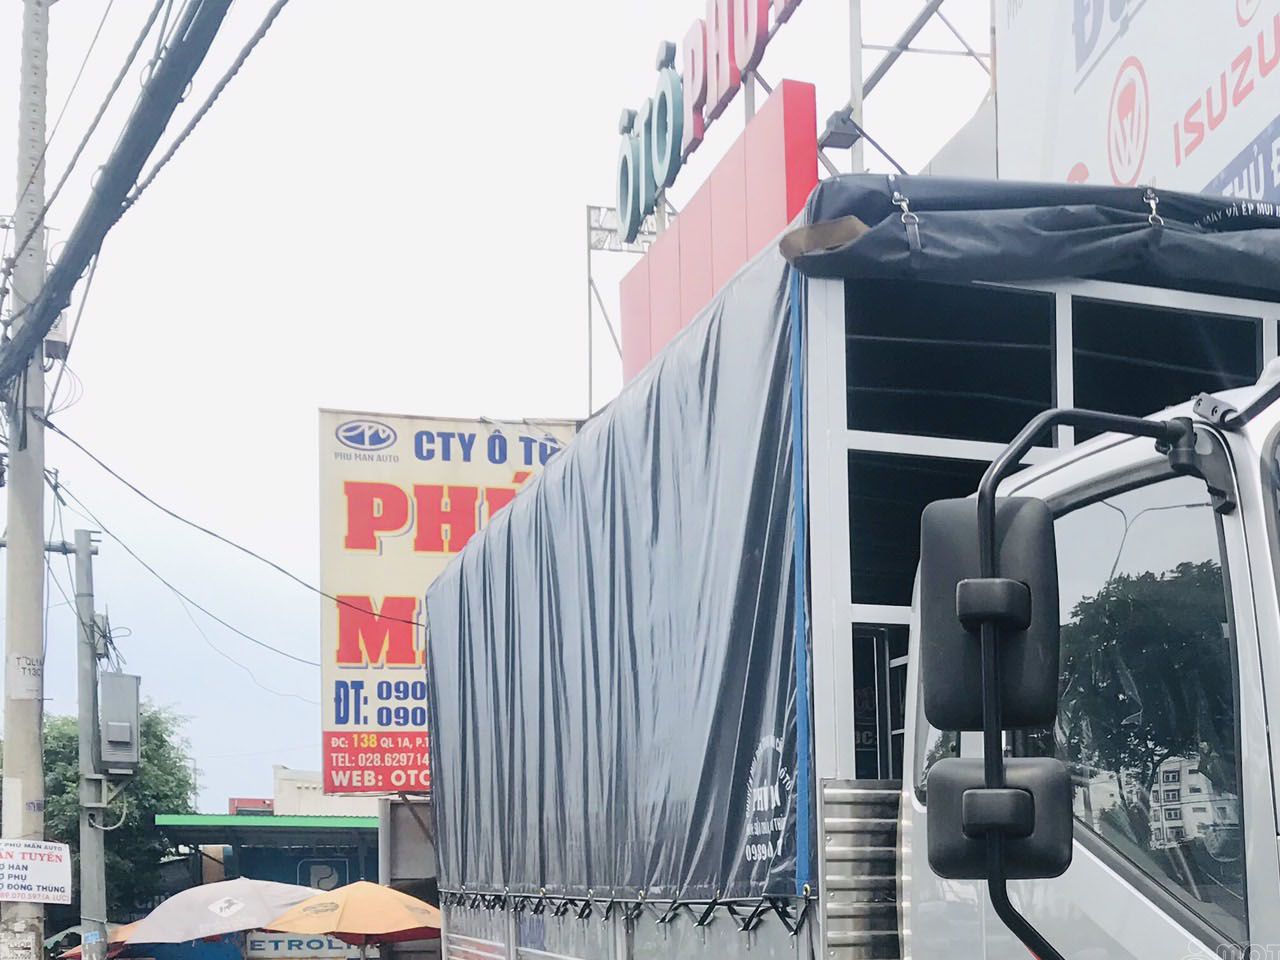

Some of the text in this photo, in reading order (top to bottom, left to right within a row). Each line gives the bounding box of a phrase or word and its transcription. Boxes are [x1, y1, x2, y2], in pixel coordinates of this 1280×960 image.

[414, 430, 476, 462] CTY
[487, 429, 508, 465] Ô
[376, 453, 399, 463] AUTO
[333, 679, 368, 725] ĐT:
[352, 733, 378, 748] 138
[380, 737, 394, 748] QL
[330, 753, 356, 767] TEL:
[330, 770, 383, 787] WEB:
